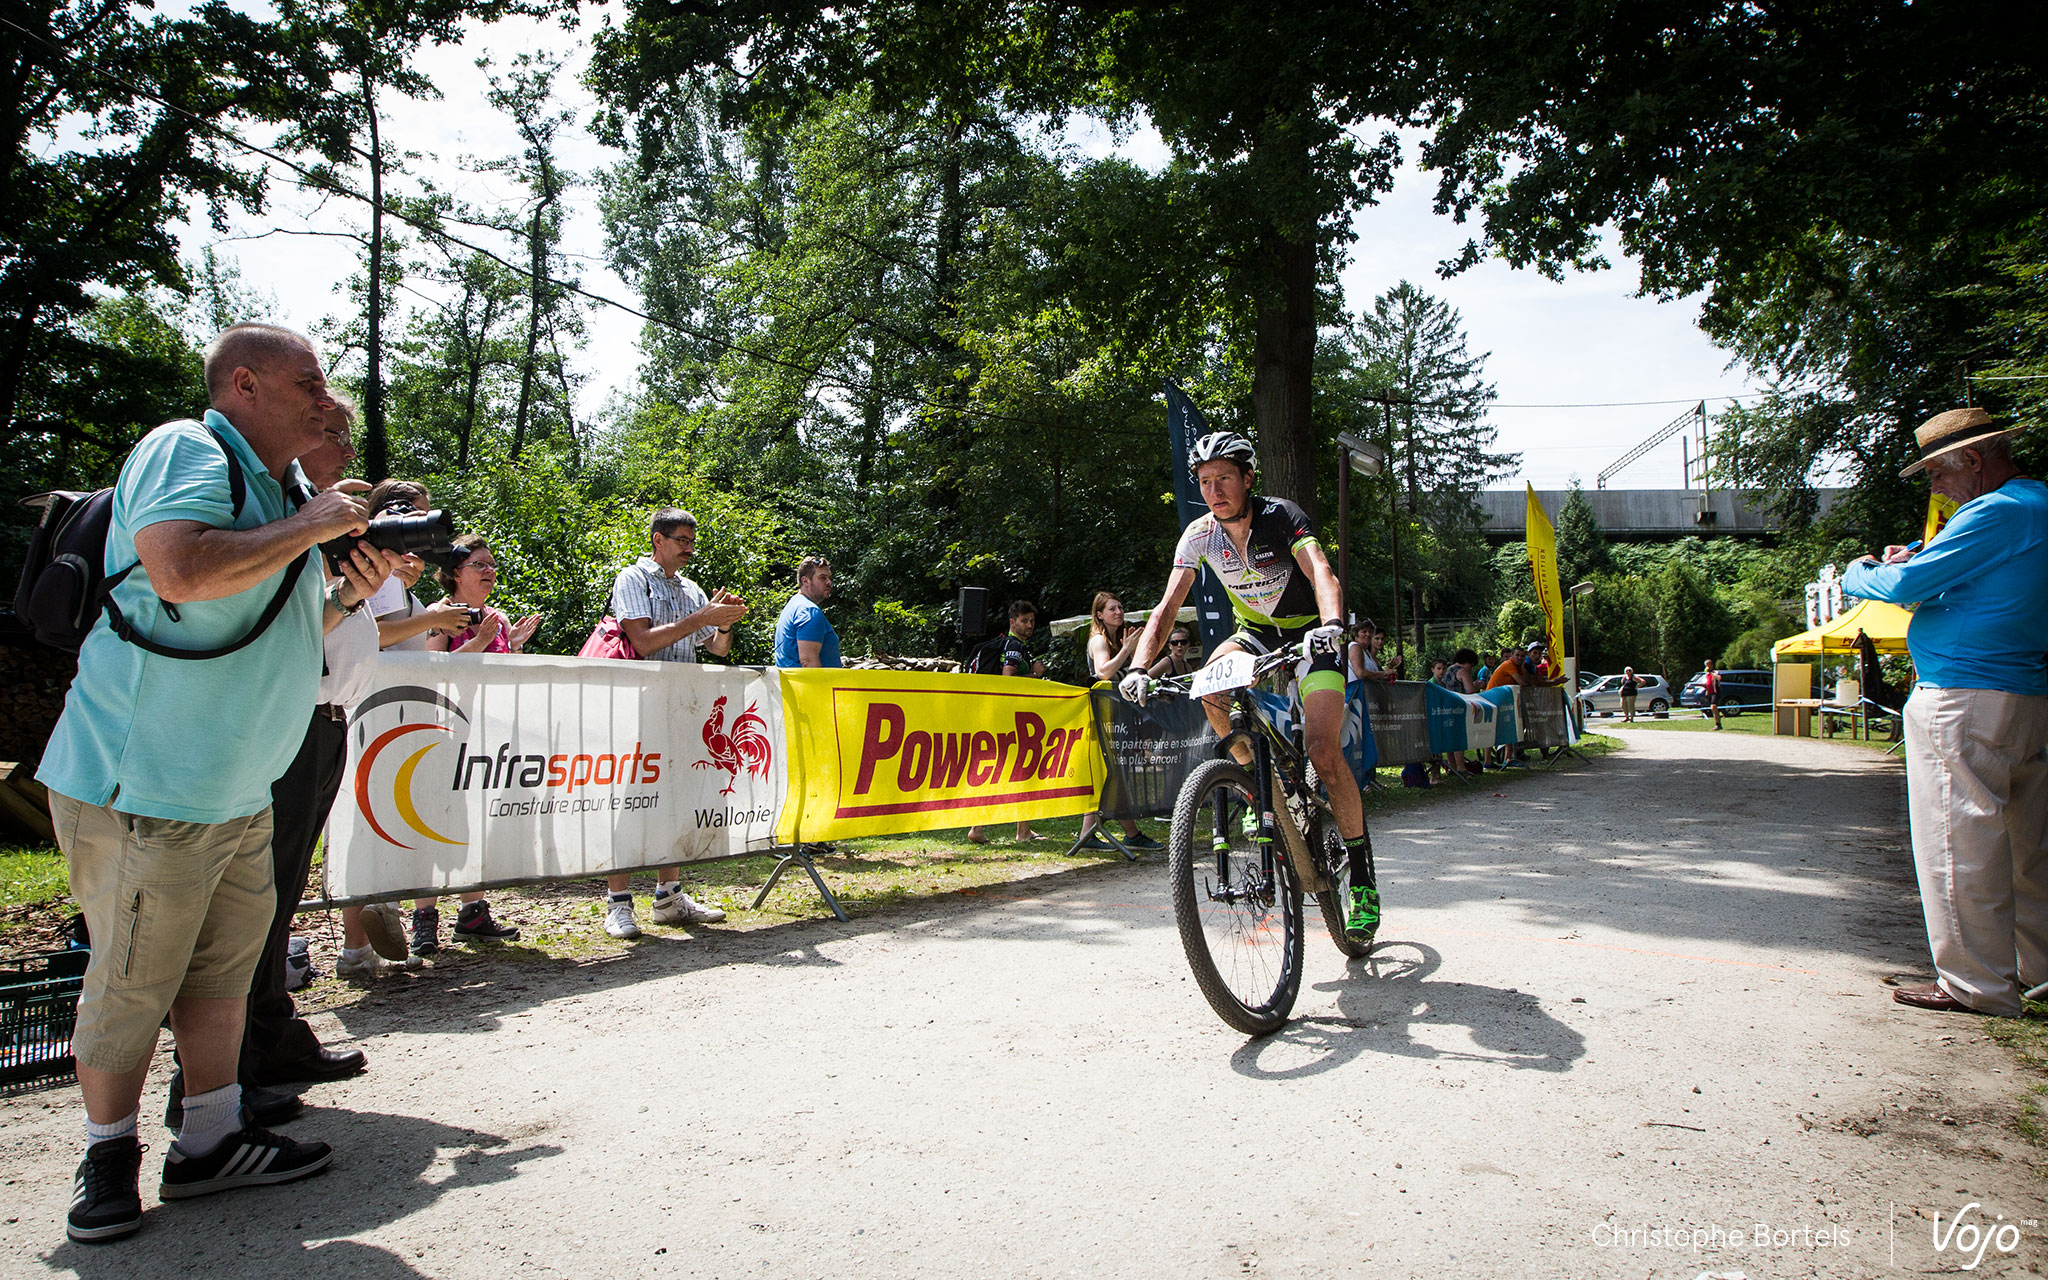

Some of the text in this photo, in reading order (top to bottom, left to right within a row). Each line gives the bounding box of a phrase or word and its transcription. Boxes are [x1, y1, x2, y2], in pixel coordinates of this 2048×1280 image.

[1206, 658, 1234, 683] 403
[1198, 677, 1244, 695] VALVERT
[853, 702, 1084, 795] PowerBar
[1121, 738, 1169, 752] partenaire
[1170, 740, 1180, 749] en
[452, 742, 661, 793] Infrasports
[1129, 754, 1147, 766] plus
[1150, 752, 1182, 765] encore!
[489, 791, 659, 818] Construire pour le sport
[694, 805, 771, 829] Wallonie
